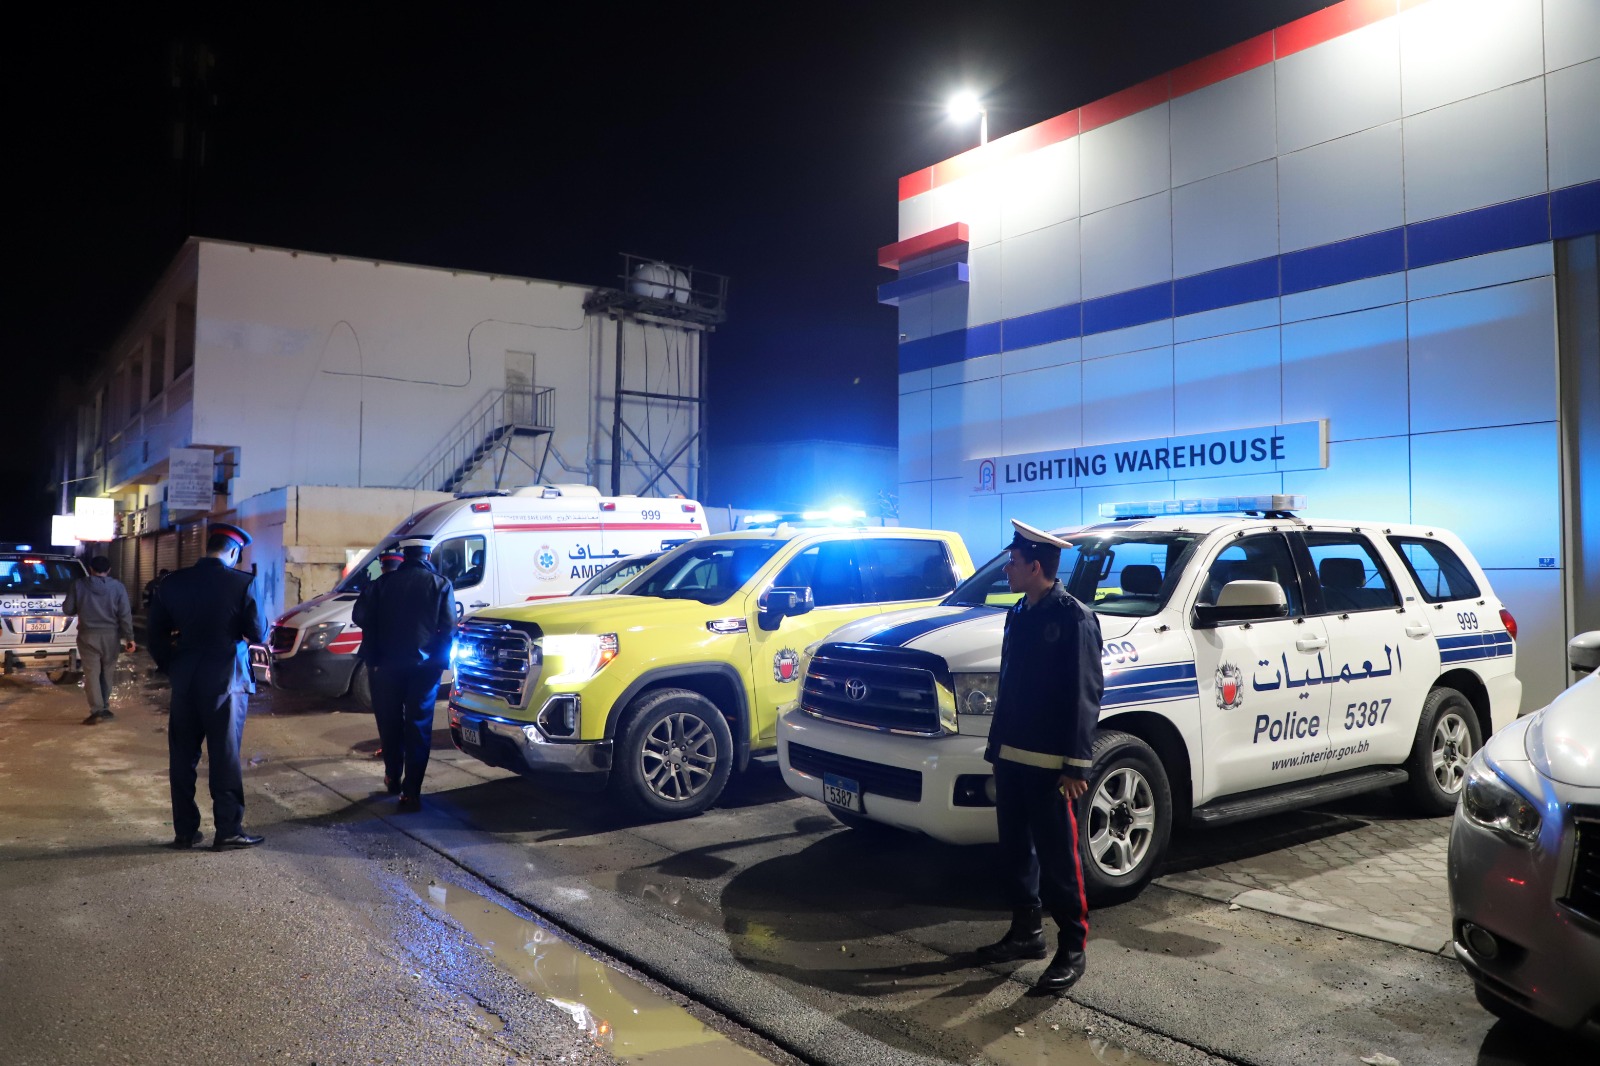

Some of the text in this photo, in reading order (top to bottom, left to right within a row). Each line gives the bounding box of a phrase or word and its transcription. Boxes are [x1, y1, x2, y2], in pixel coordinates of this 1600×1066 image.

[1005, 435, 1286, 484] LIGHTING WAREHOUSE
[641, 509, 661, 521] 999
[1457, 611, 1479, 630] 999
[1252, 643, 1402, 700] العمليات
[1252, 710, 1321, 744] Police
[1344, 697, 1392, 731] 5387
[1271, 739, 1370, 771] www.interior.gov.bh
[830, 786, 852, 808] 5387
